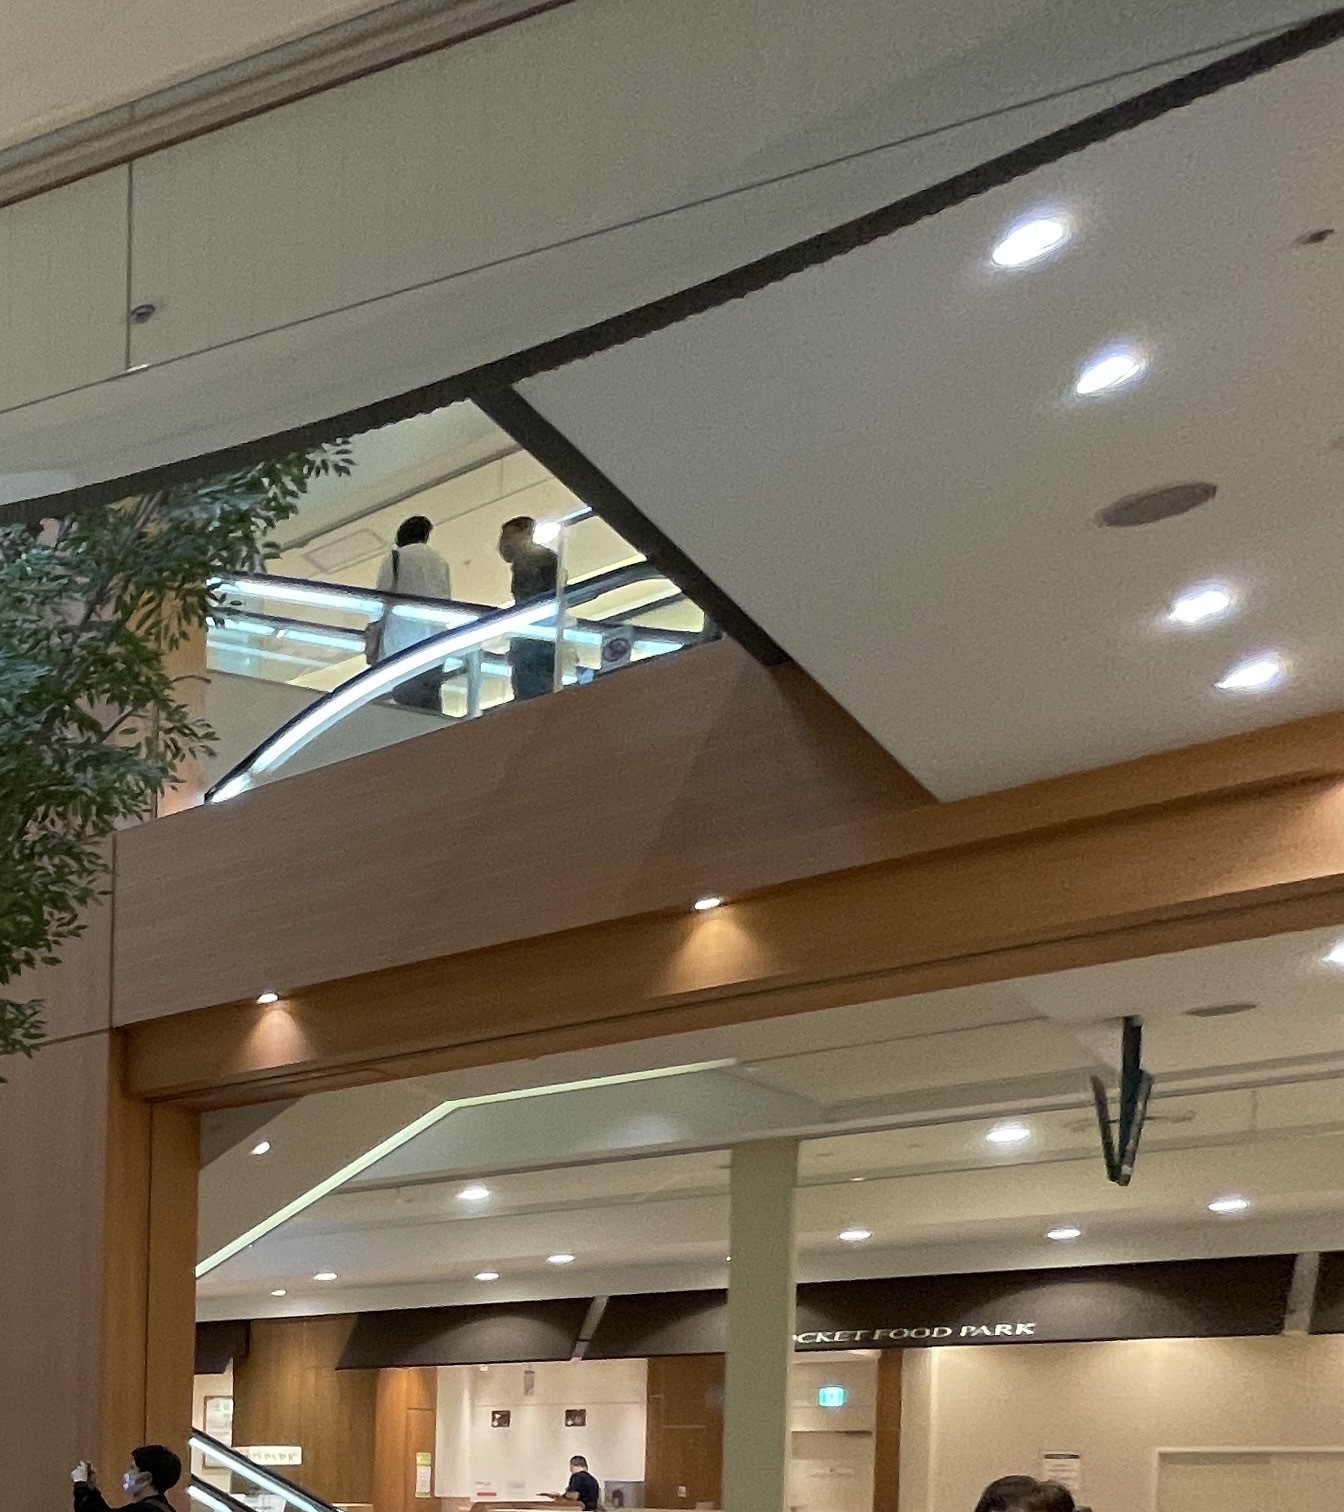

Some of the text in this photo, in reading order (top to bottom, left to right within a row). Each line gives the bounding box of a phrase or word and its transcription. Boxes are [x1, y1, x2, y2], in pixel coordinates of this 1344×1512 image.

[792, 1322, 1037, 1344] CKET FOOD PARK
